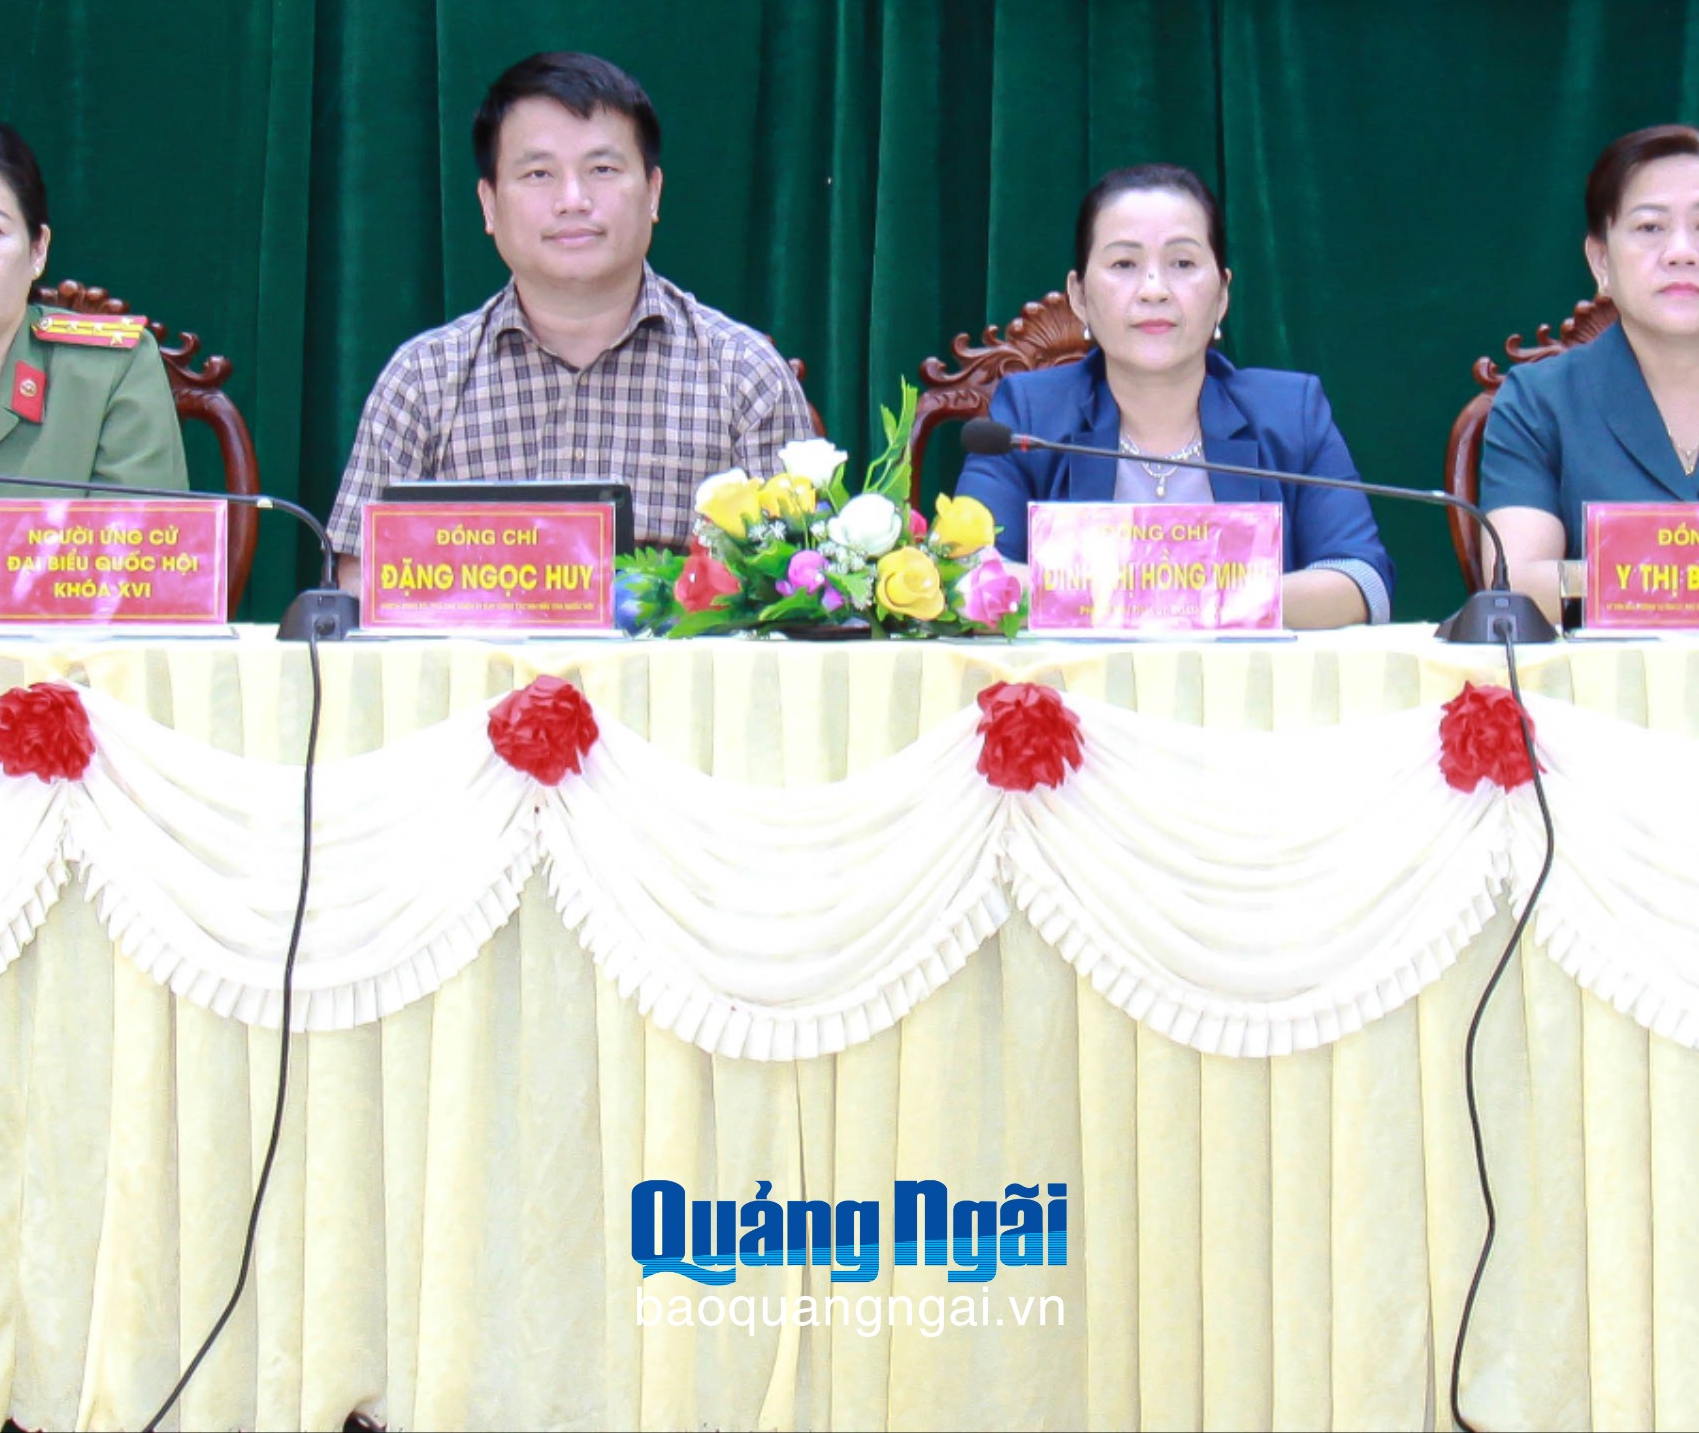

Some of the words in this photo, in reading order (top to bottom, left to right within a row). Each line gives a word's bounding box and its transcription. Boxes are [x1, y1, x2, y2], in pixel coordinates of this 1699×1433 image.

[100, 526, 143, 545] ỨNG
[150, 525, 179, 545] CỬ
[436, 524, 496, 545] ĐỒNG
[503, 526, 538, 545] CHÍ
[1172, 522, 1209, 540] CHÍ
[48, 549, 88, 571] BIỂU
[95, 551, 155, 572] QUỐC
[162, 553, 197, 575] HỘI
[1142, 548, 1206, 590] HỒNG
[54, 579, 112, 598] KHÓA
[118, 583, 150, 597] XVI
[381, 558, 454, 596] ĐẶNG
[462, 565, 537, 596] NGỌC
[546, 565, 593, 589] HUY
[1616, 565, 1632, 590] Y
[1640, 565, 1677, 597] THỊ
